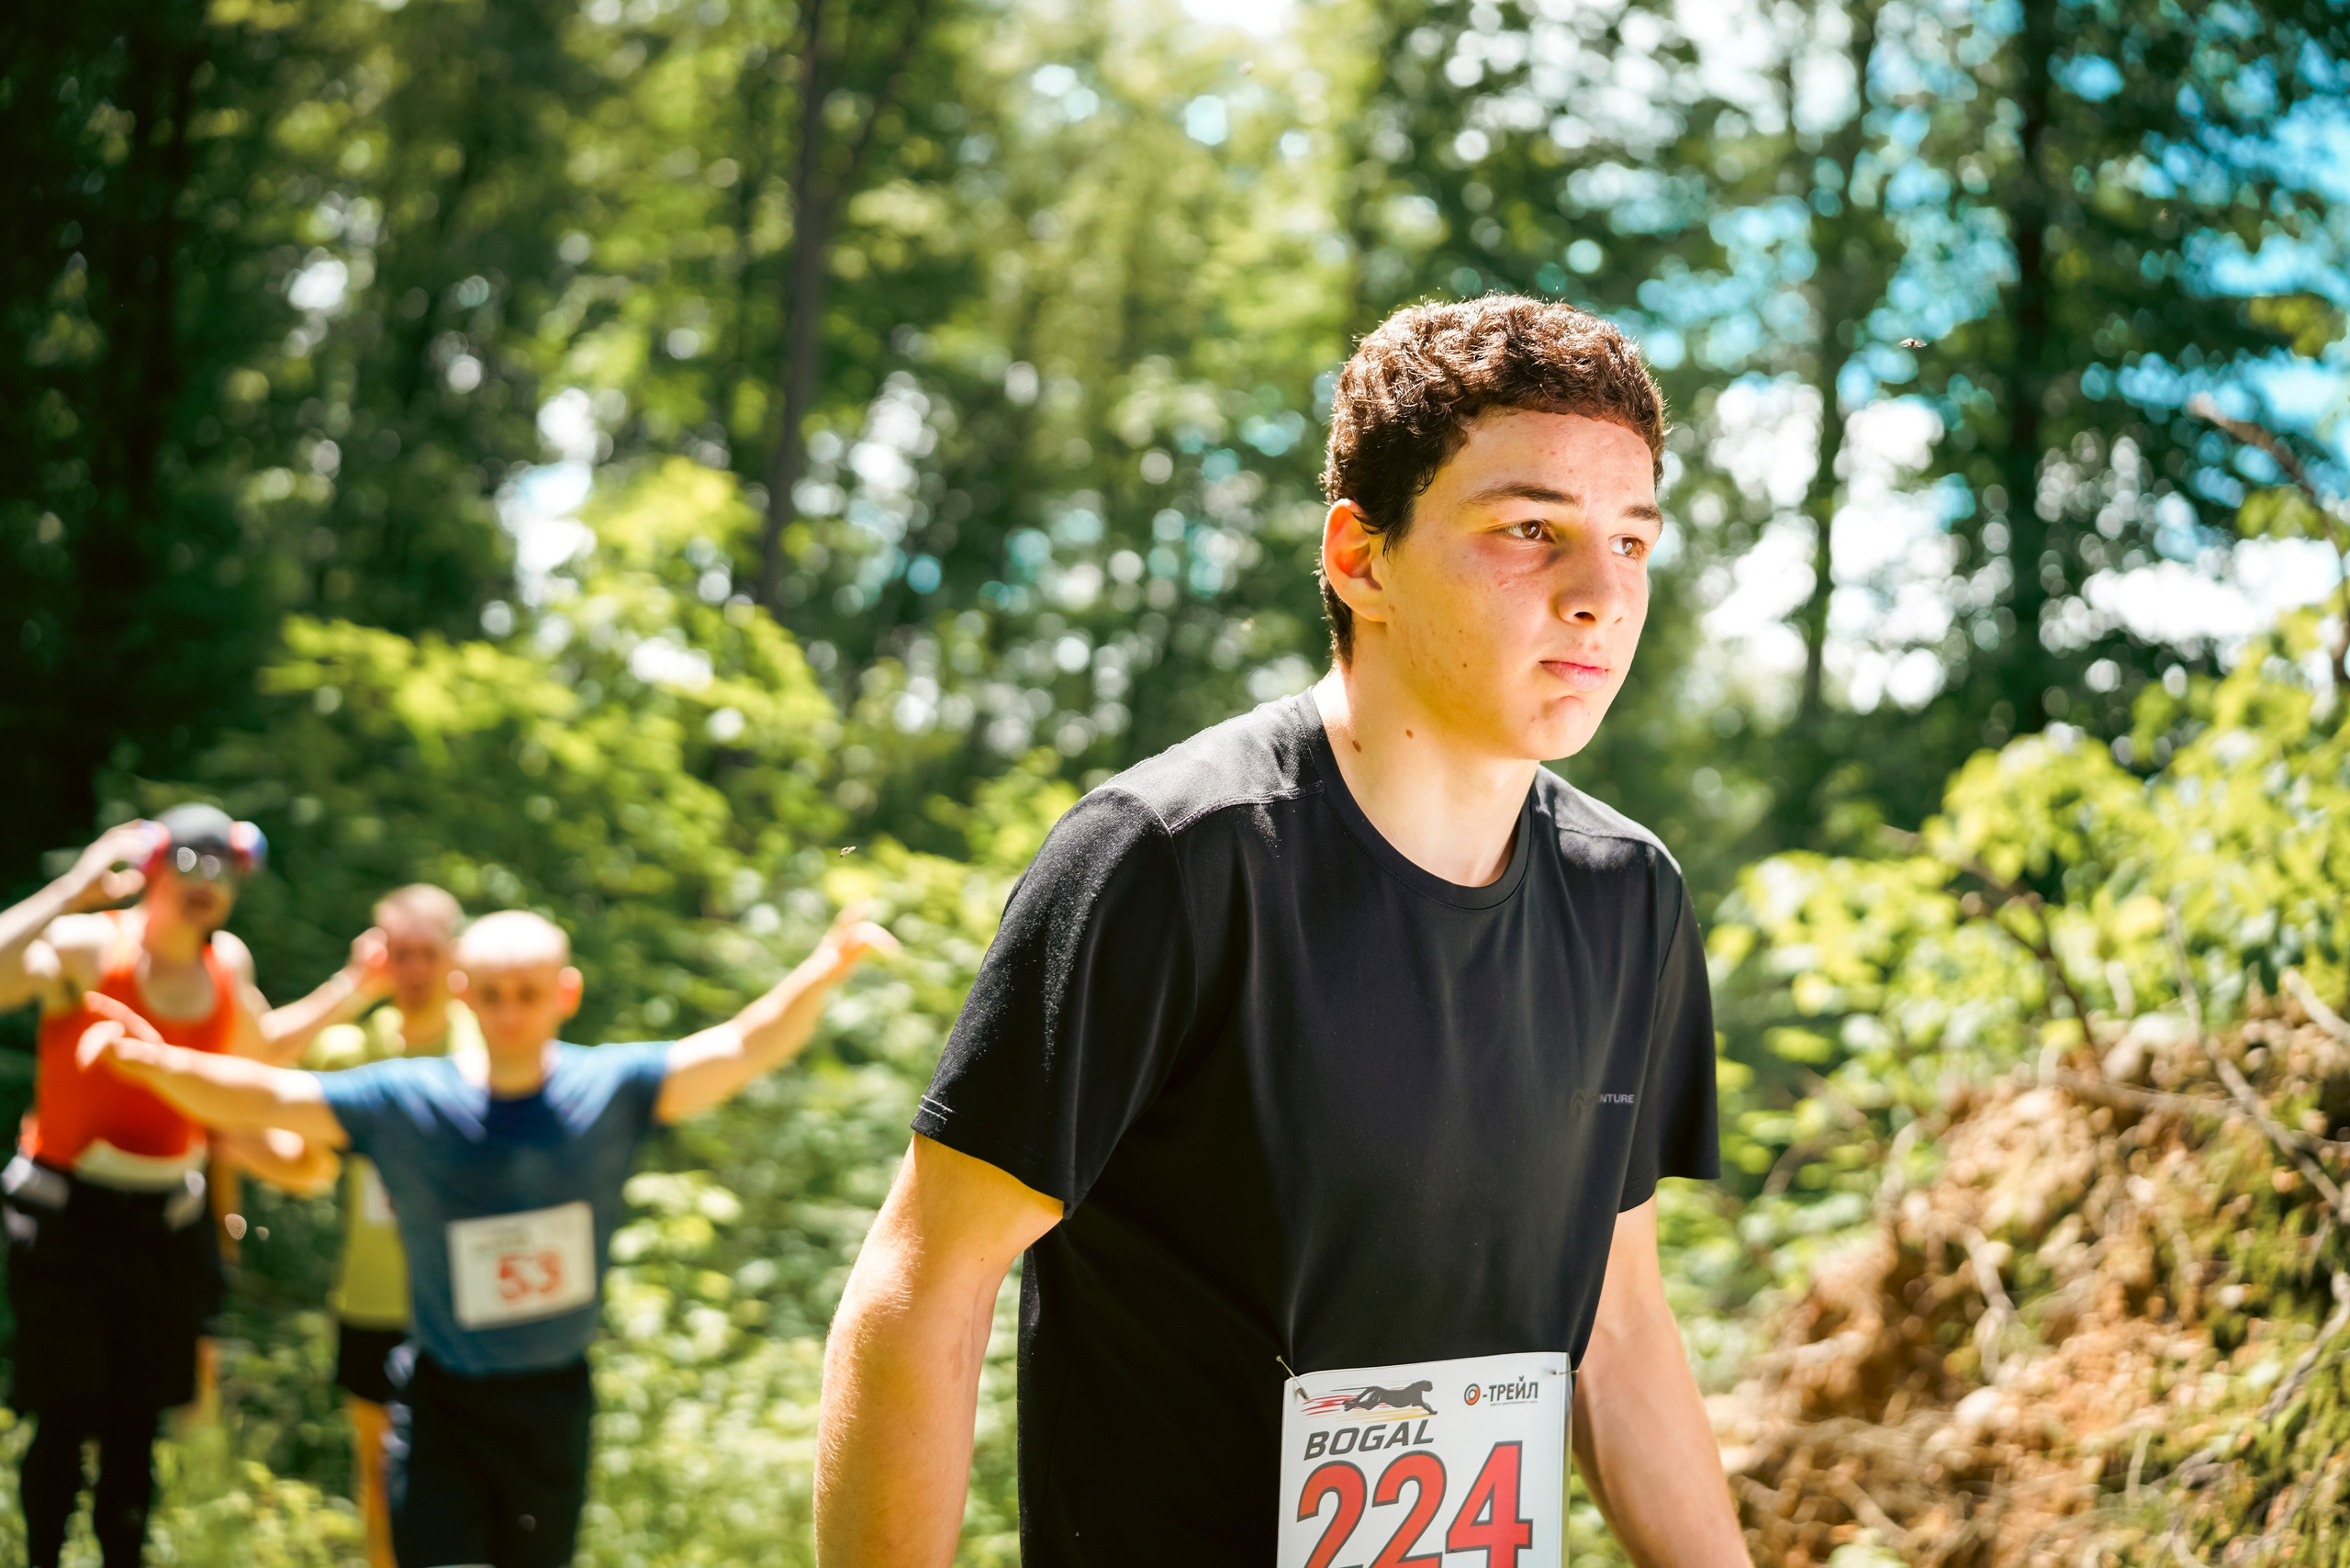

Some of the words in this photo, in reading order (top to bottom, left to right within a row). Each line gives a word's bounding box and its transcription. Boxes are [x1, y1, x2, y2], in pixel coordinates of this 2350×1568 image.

[497, 1251, 564, 1303] 53
[1304, 1418, 1435, 1462] BOGAL
[1296, 1439, 1534, 1568] 224
